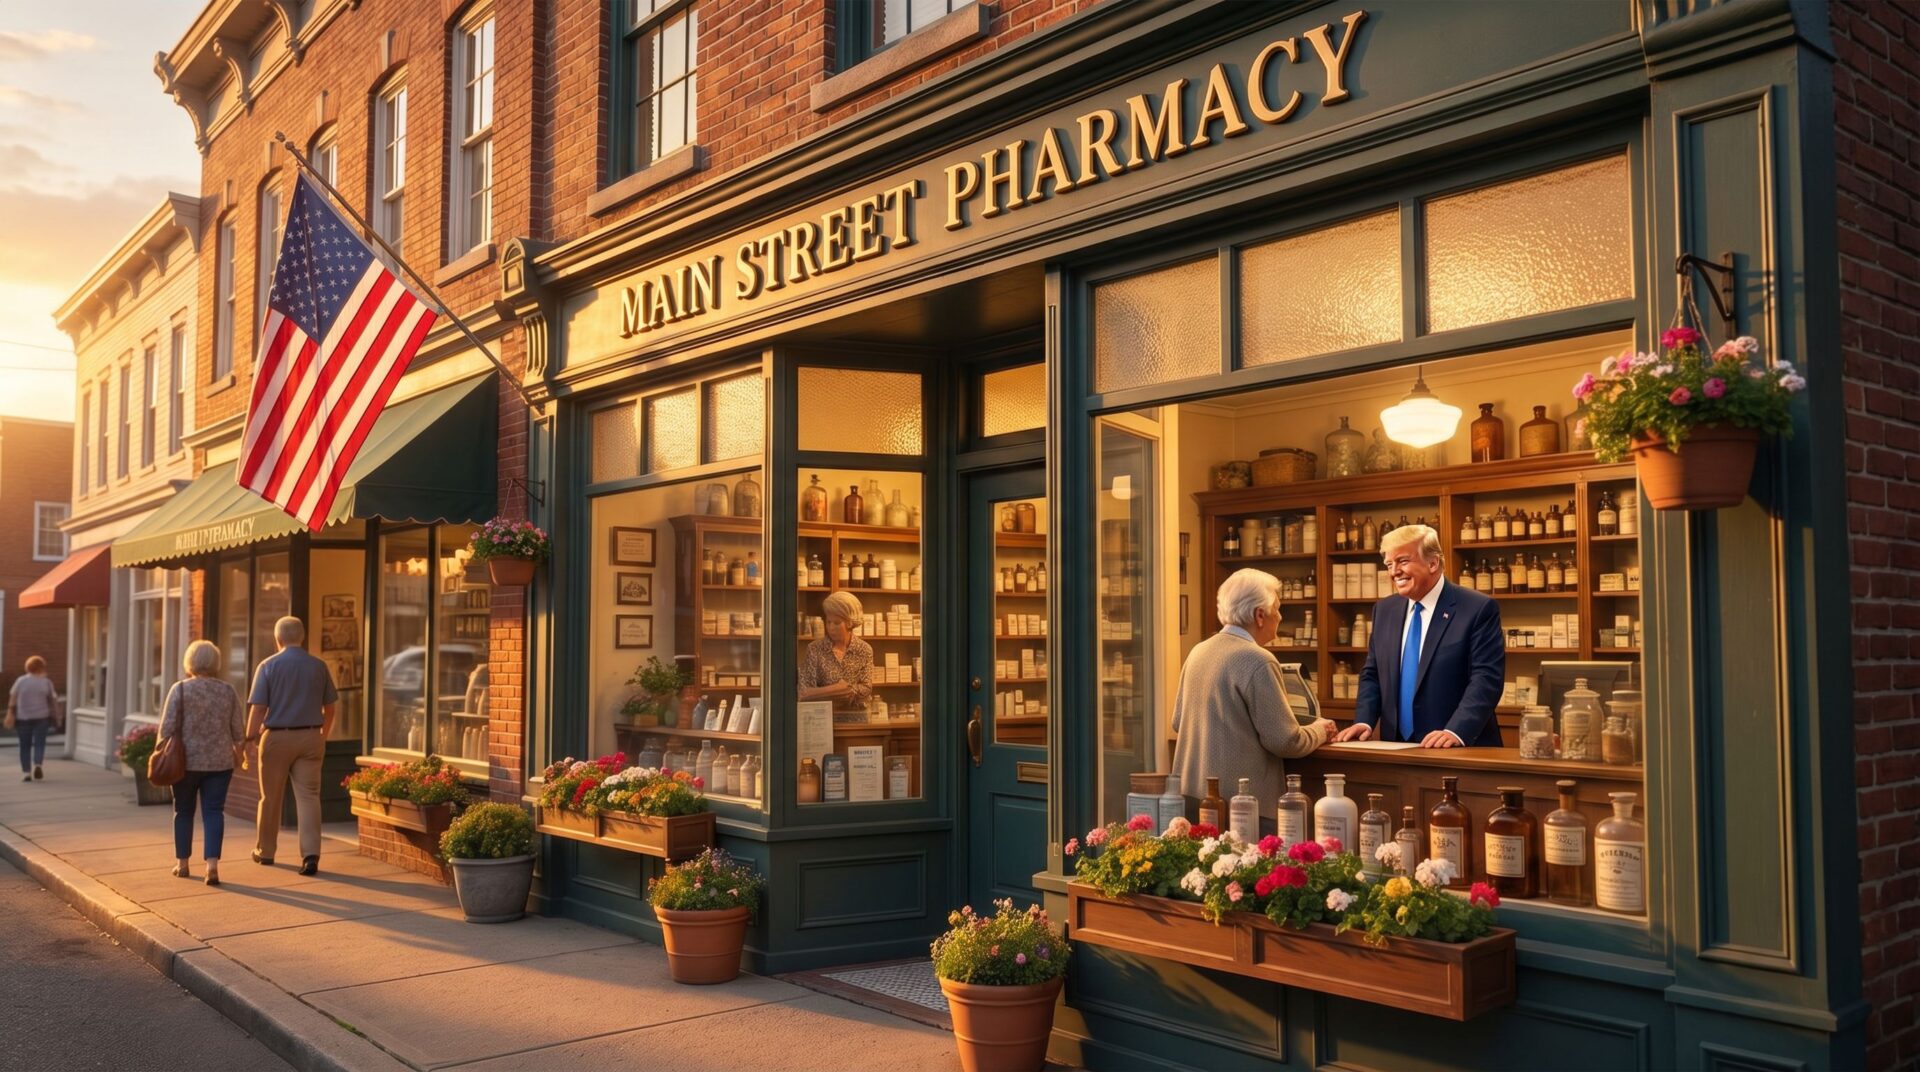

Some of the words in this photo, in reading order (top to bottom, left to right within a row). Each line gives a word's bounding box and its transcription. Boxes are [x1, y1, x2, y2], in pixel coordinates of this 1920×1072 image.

[620, 255, 723, 338] MAIN
[736, 180, 923, 300] STREET
[944, 9, 1369, 231] PHARMACY
